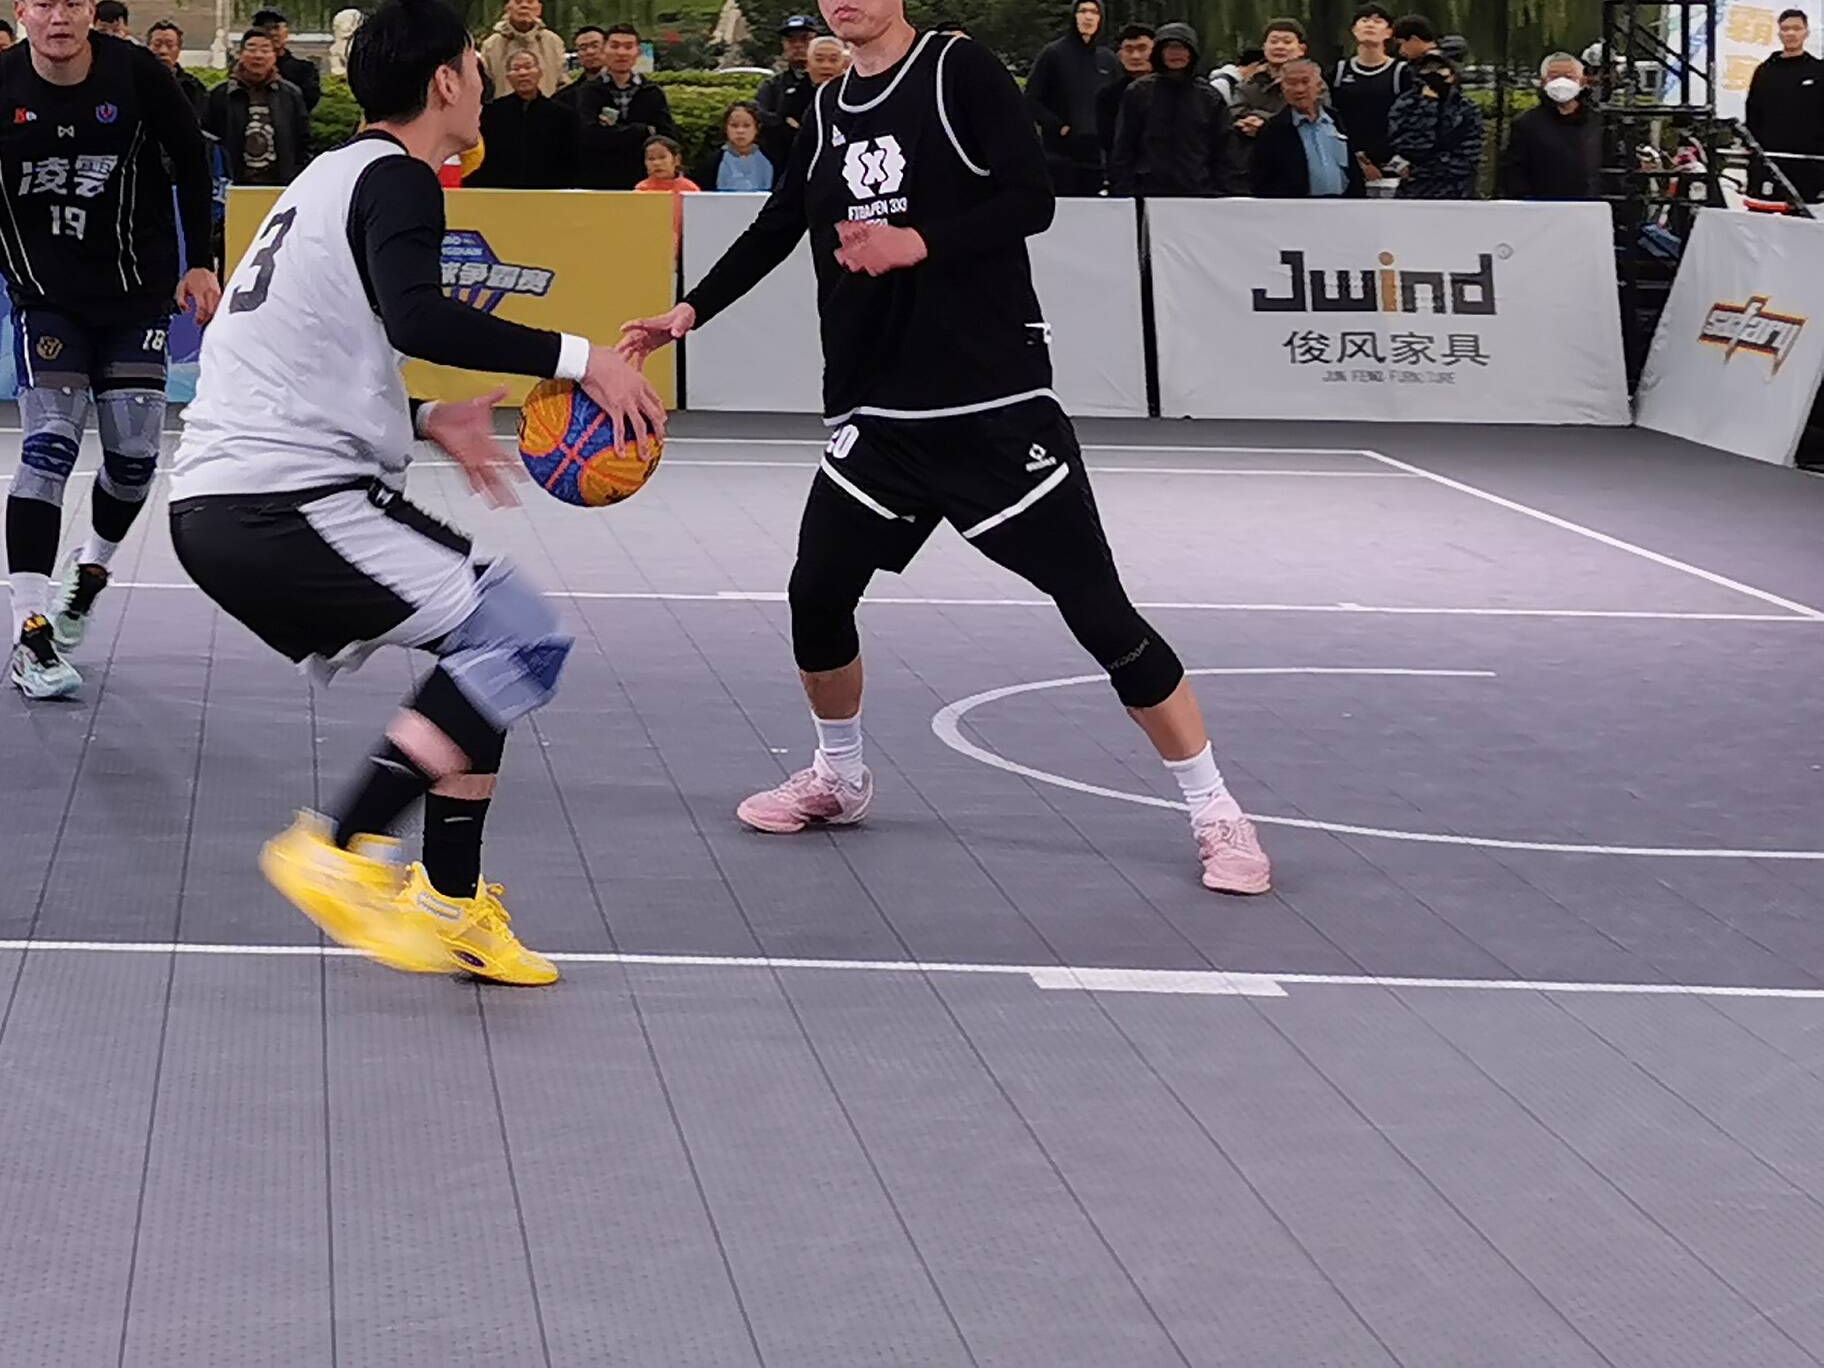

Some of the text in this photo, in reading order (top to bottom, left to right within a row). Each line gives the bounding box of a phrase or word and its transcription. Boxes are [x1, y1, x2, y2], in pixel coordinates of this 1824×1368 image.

[229, 206, 297, 314] 3
[1251, 249, 1497, 315] Jwind
[1283, 330, 1491, 366] 俊风家具
